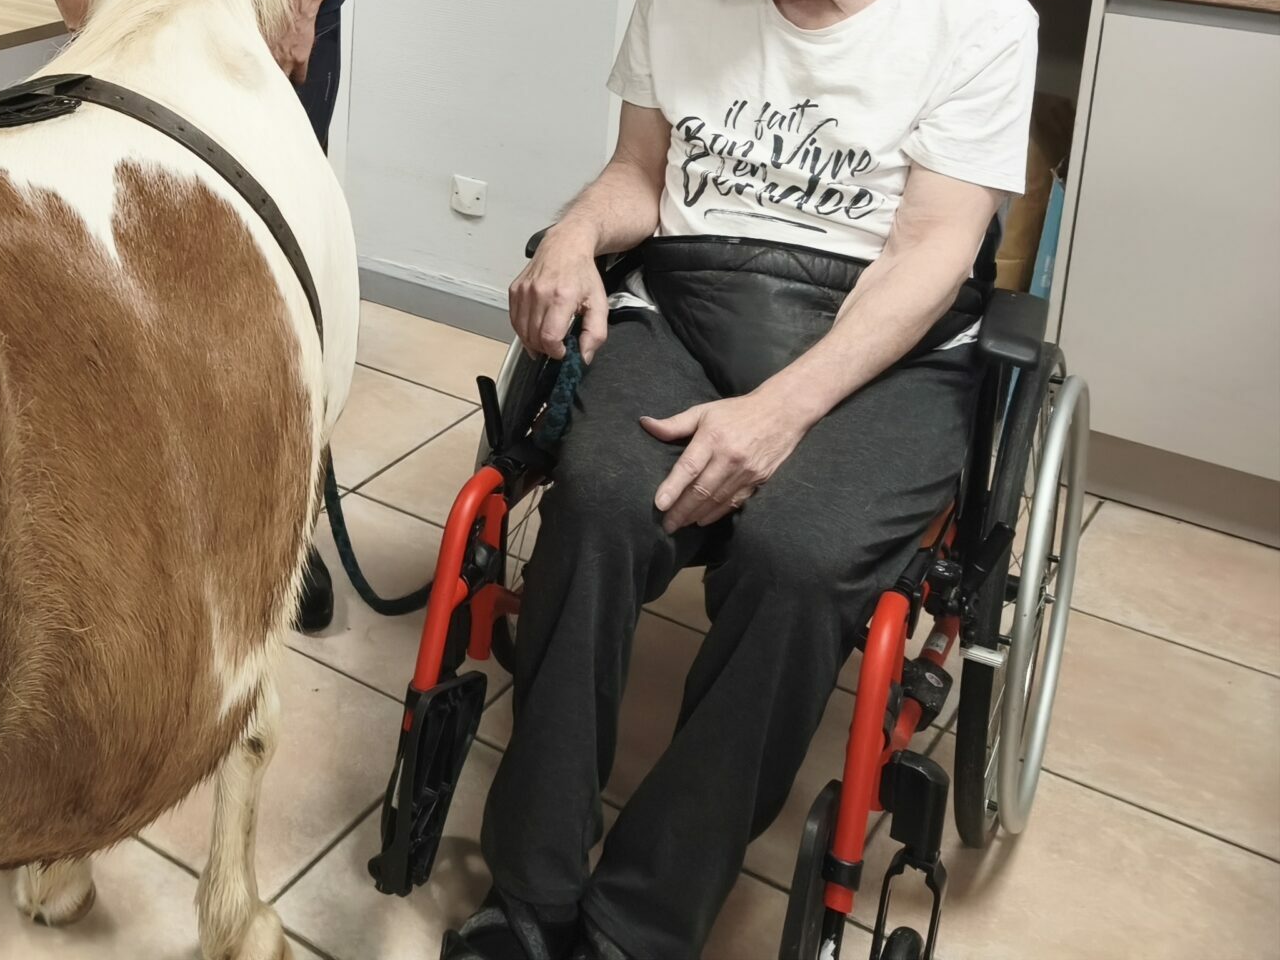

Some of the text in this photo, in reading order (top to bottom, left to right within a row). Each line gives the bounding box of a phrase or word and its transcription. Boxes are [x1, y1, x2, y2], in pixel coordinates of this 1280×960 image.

[754, 98, 819, 141] fait
[676, 116, 881, 180] Bon Vivre
[732, 158, 768, 183] en
